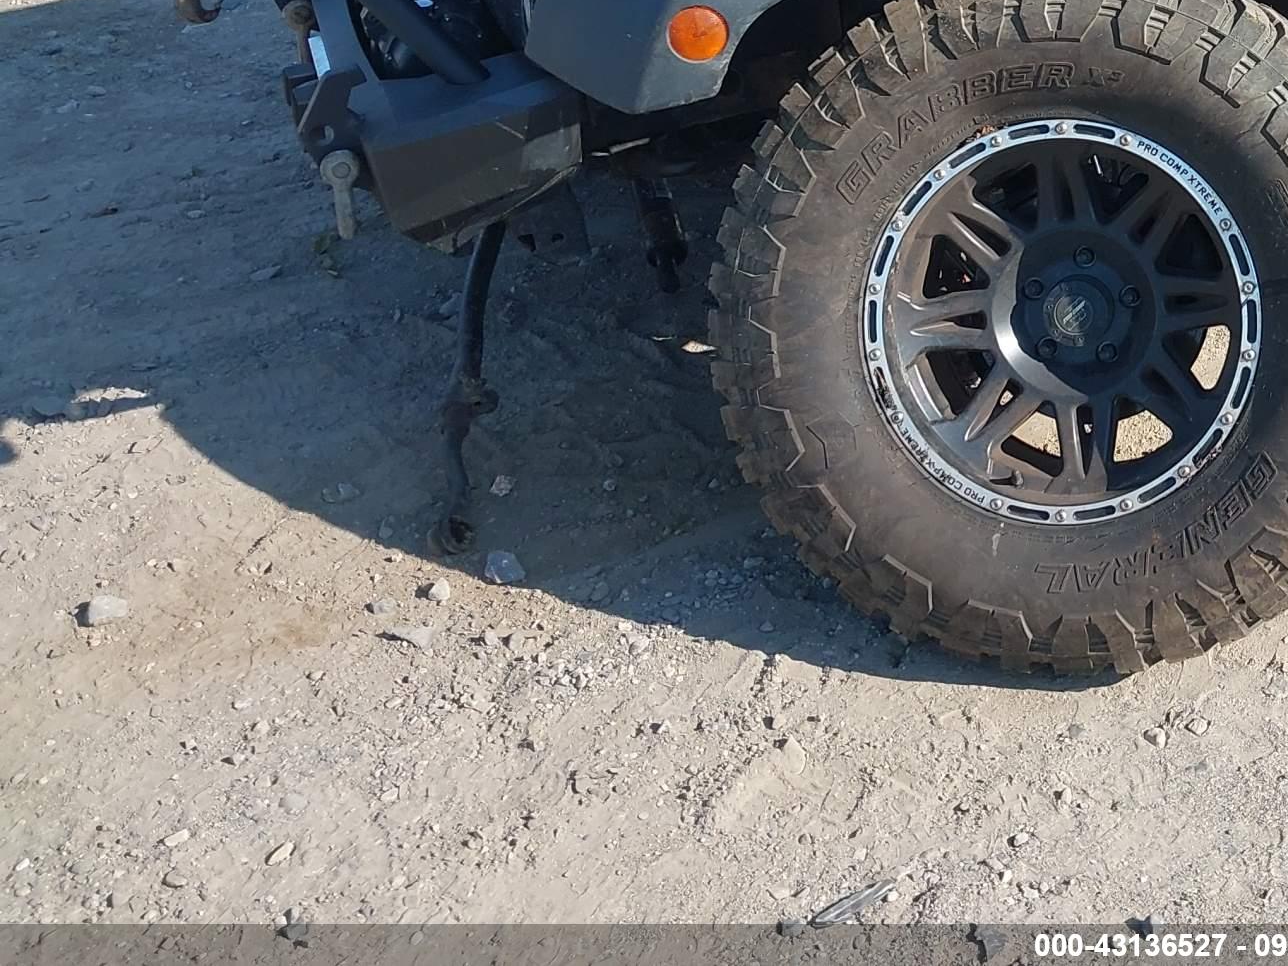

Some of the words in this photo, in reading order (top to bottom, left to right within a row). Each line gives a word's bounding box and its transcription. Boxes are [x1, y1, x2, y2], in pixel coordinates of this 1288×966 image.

[836, 61, 1076, 205] GRABBER
[1136, 140, 1159, 157] PRO
[1160, 153, 1189, 176] COMP
[1188, 174, 1223, 216] XTREME
[963, 487, 986, 505] PRO
